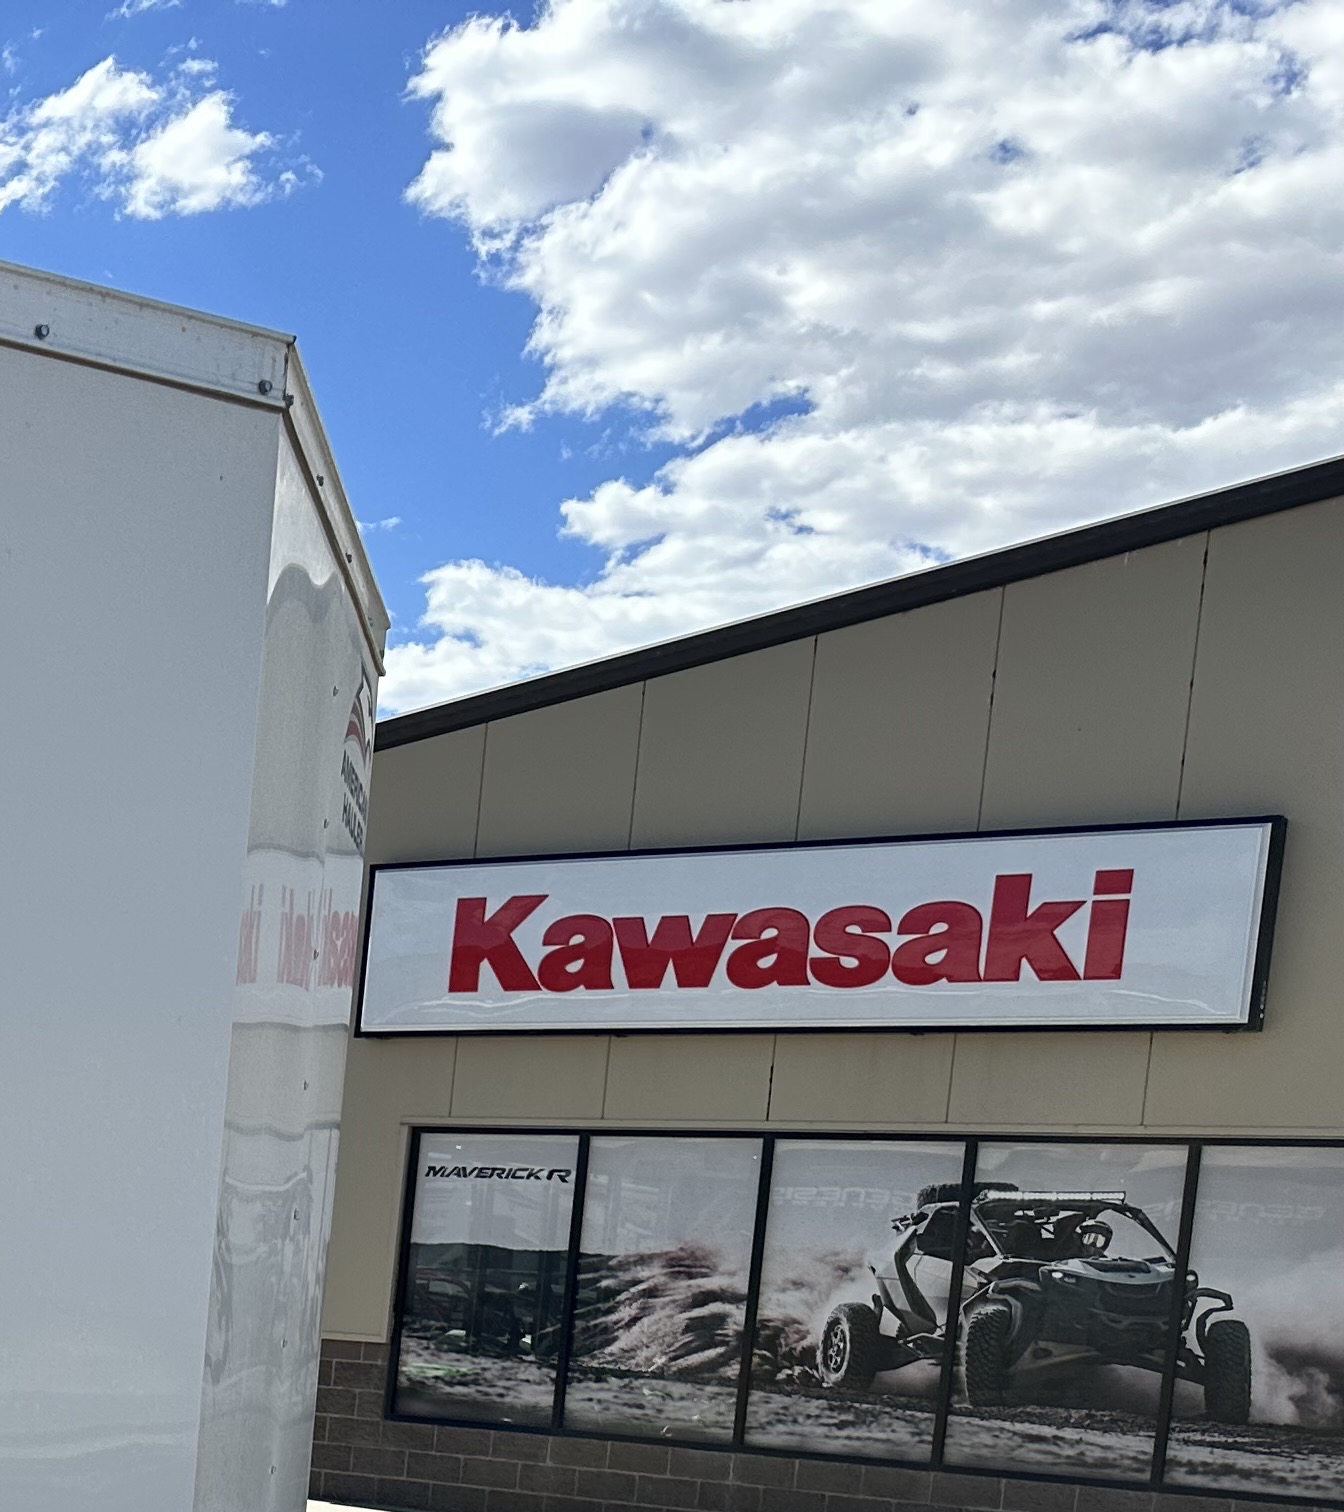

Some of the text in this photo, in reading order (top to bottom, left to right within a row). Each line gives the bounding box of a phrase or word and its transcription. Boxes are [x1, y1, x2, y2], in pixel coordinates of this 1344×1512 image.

[447, 868, 1135, 994] Kawasaki
[425, 1165, 572, 1184] MAVERICK R
